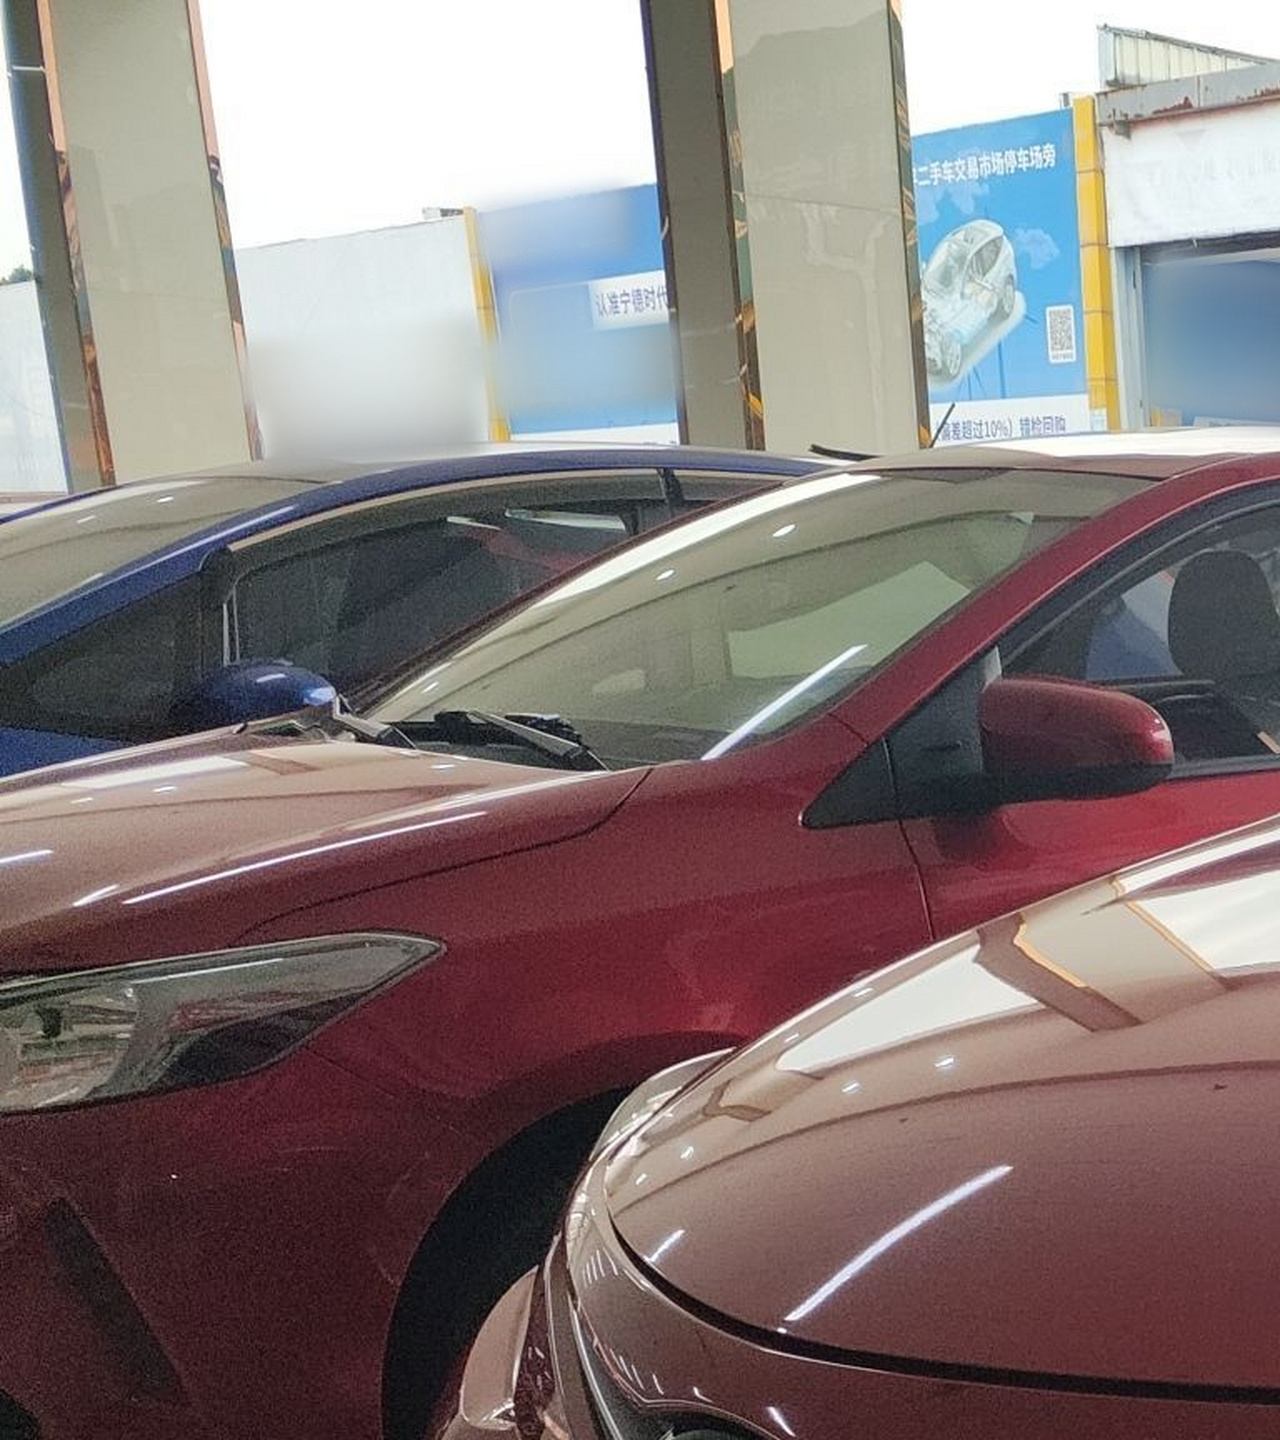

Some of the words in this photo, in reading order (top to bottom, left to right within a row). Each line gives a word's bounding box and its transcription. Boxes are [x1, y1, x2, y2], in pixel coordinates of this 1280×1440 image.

[912, 142, 1056, 186] 二手车交易市场停车场旁
